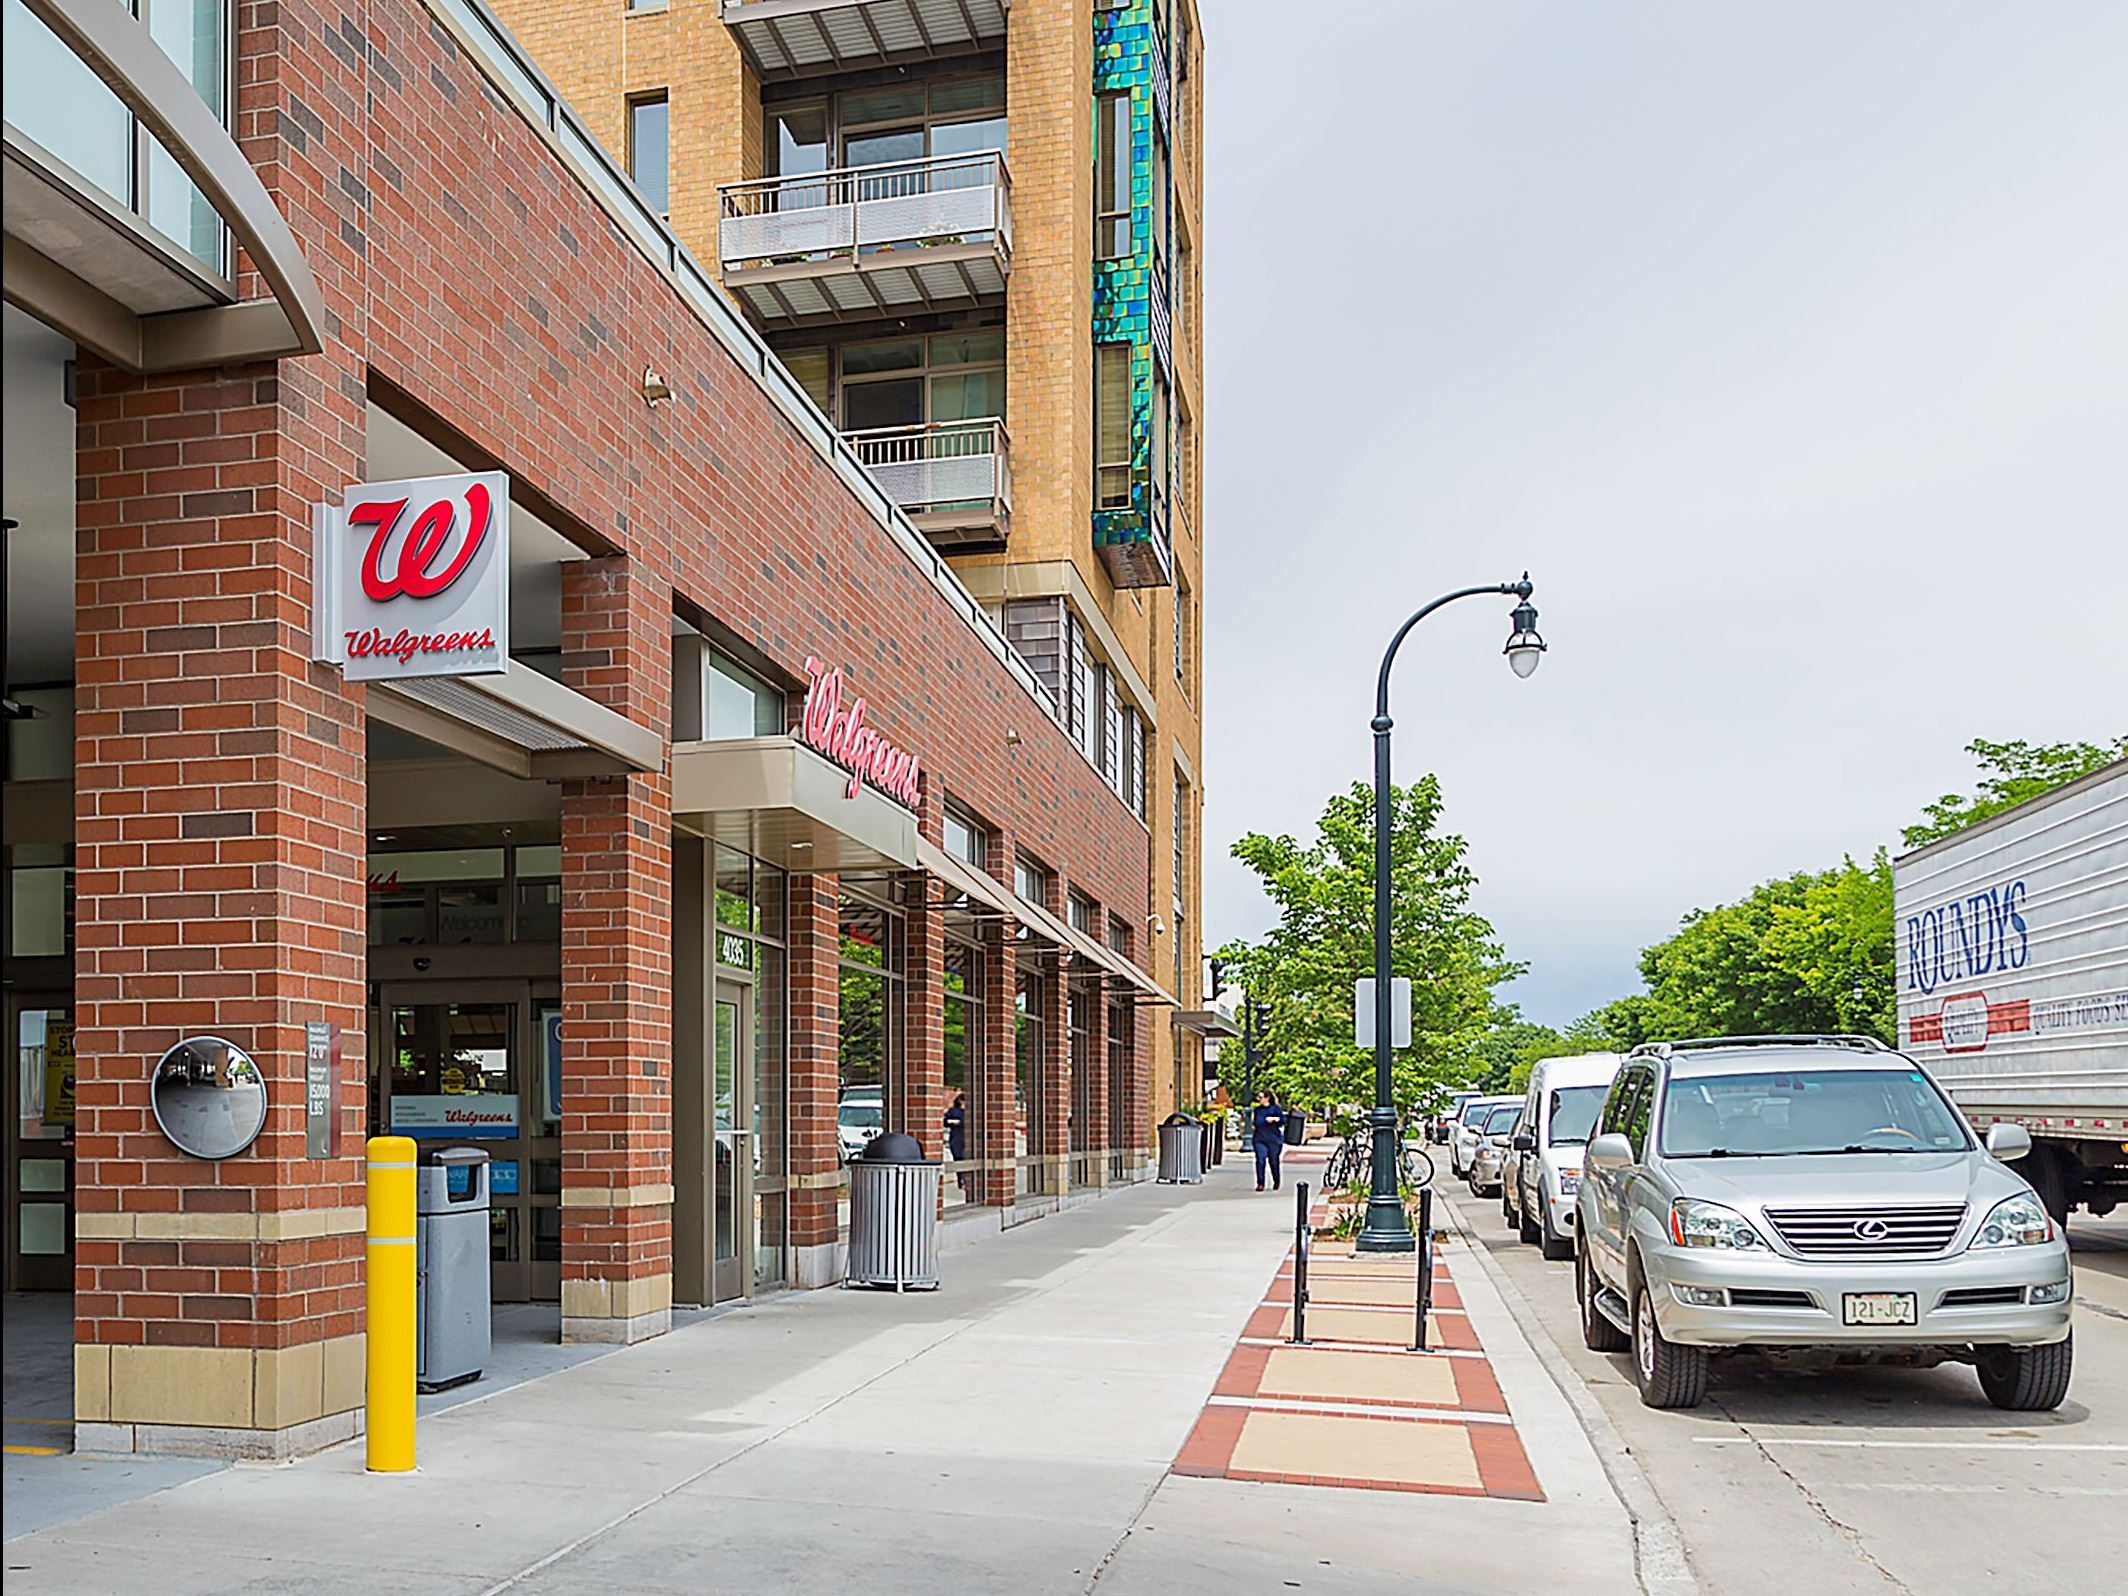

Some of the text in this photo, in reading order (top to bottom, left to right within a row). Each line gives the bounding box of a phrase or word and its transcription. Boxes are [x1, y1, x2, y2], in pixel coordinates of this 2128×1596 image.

[347, 482, 492, 602] W
[343, 626, 497, 665] Walgreens
[803, 655, 922, 807] Walgreens
[722, 935, 745, 967] 4035
[444, 1109, 513, 1127] Walgreens
[1851, 1301, 1911, 1318] 121-JCZ
